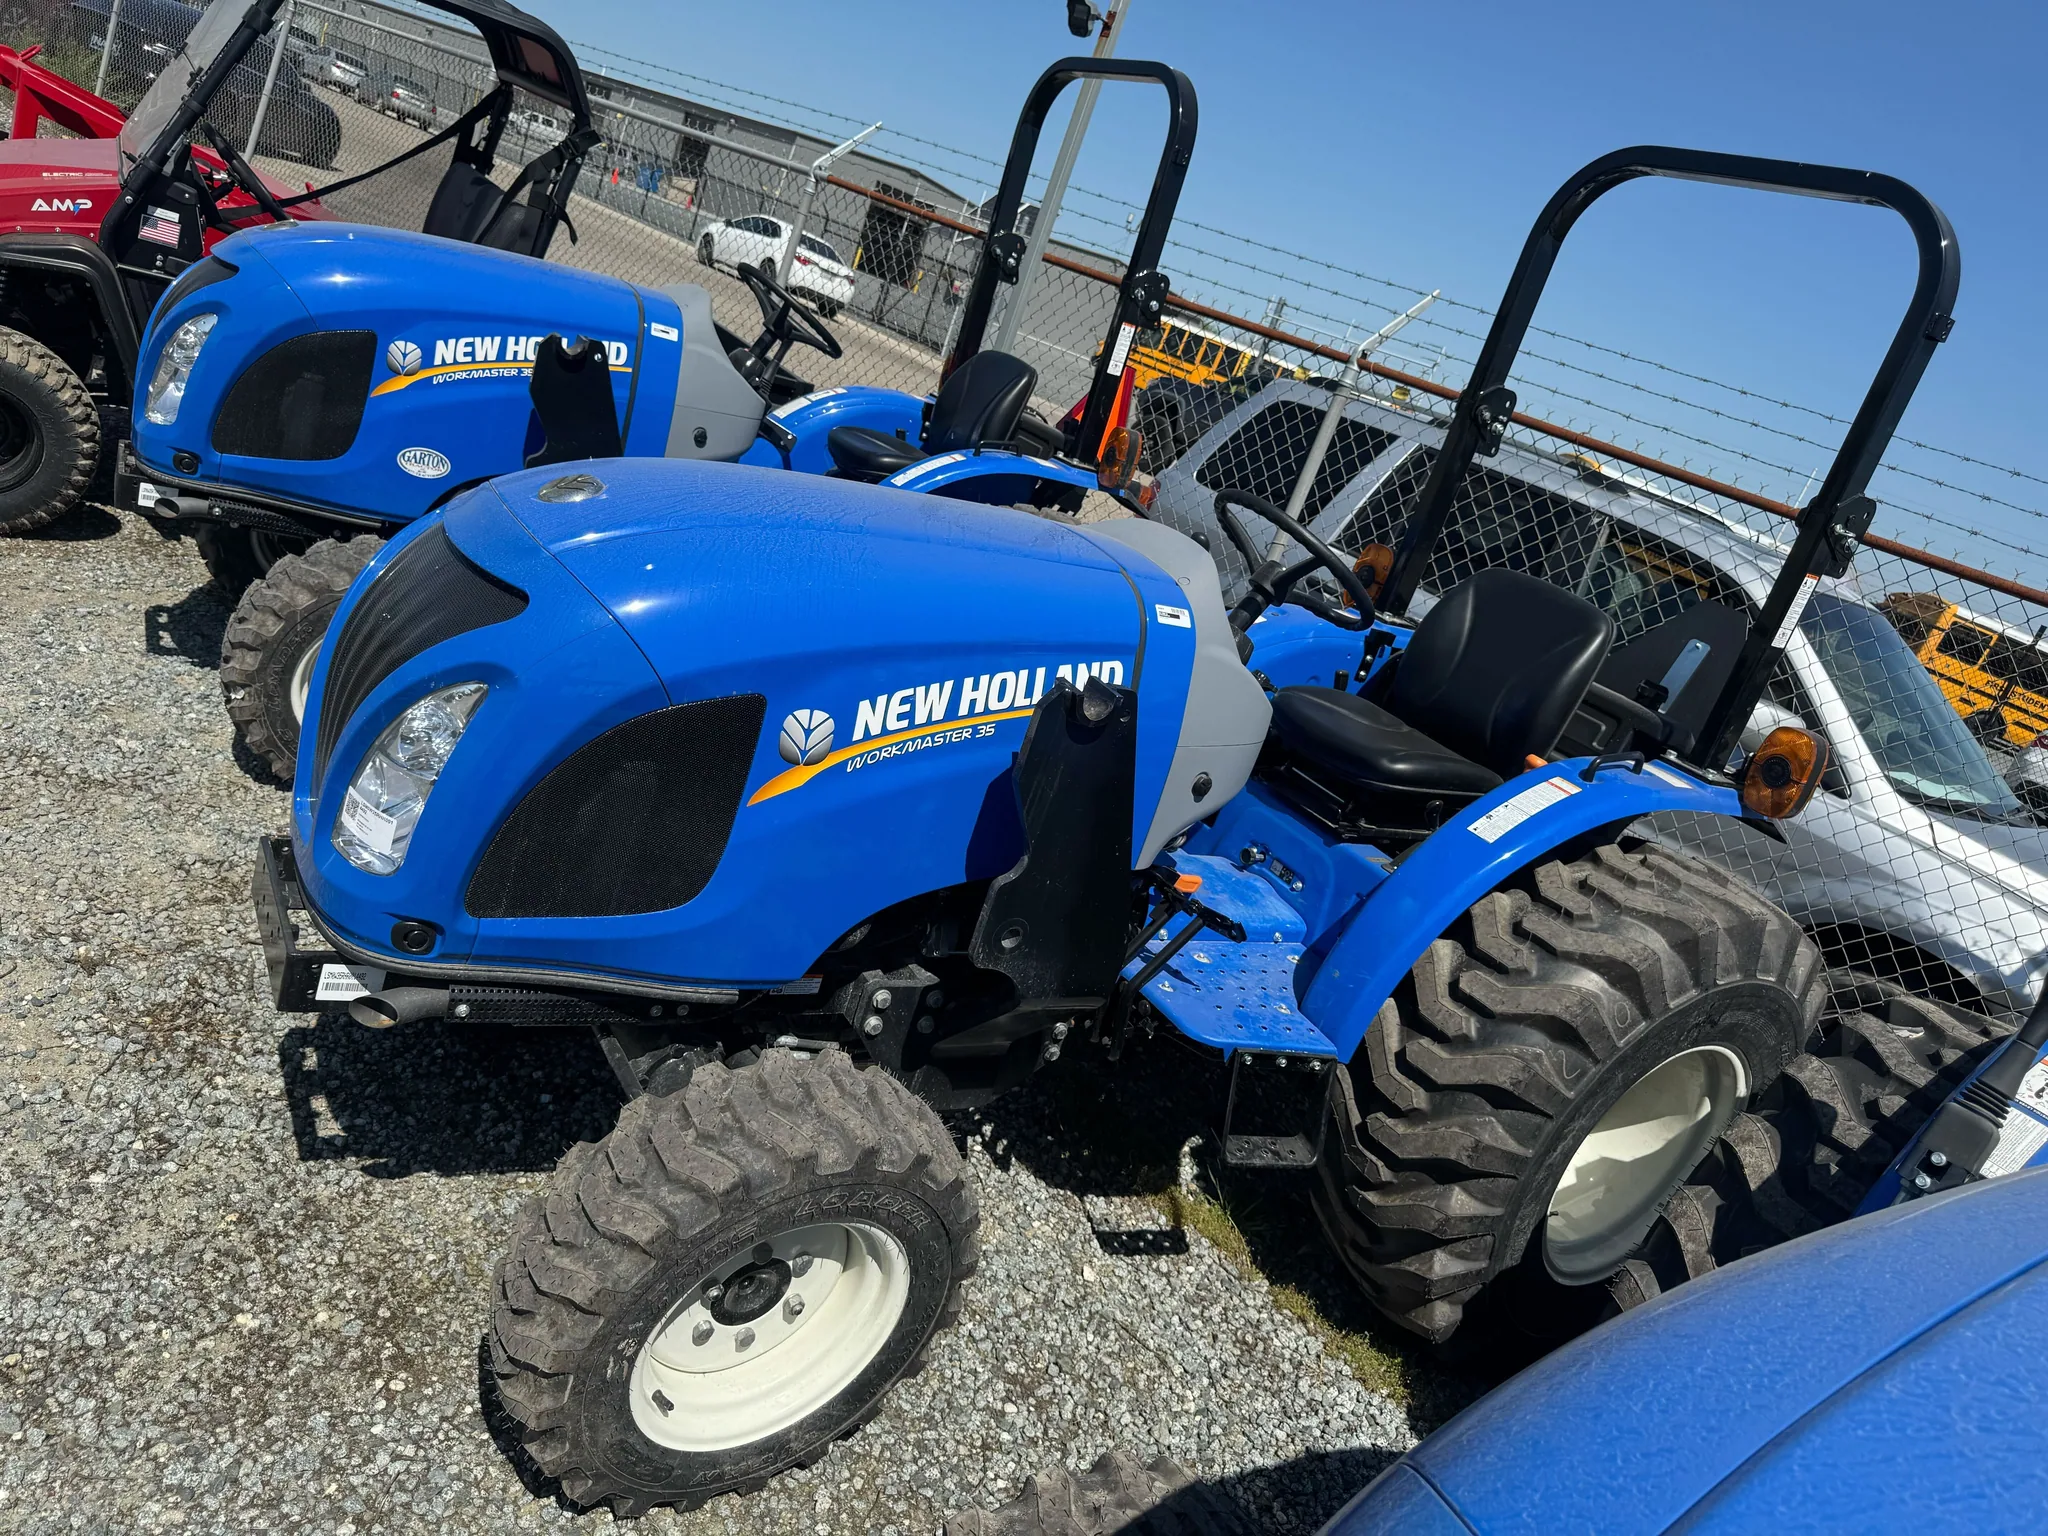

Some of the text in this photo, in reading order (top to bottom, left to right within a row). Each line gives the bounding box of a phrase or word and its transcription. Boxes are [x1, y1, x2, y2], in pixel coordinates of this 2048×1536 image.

[31, 198, 93, 215] AMP
[433, 336, 502, 366] NEW
[433, 368, 519, 384] WORKMASTER
[402, 450, 447, 470] GARTON
[852, 679, 955, 741] NEW
[2008, 690, 2048, 711] STUDEN
[846, 723, 996, 773] WORKMASTER 35
